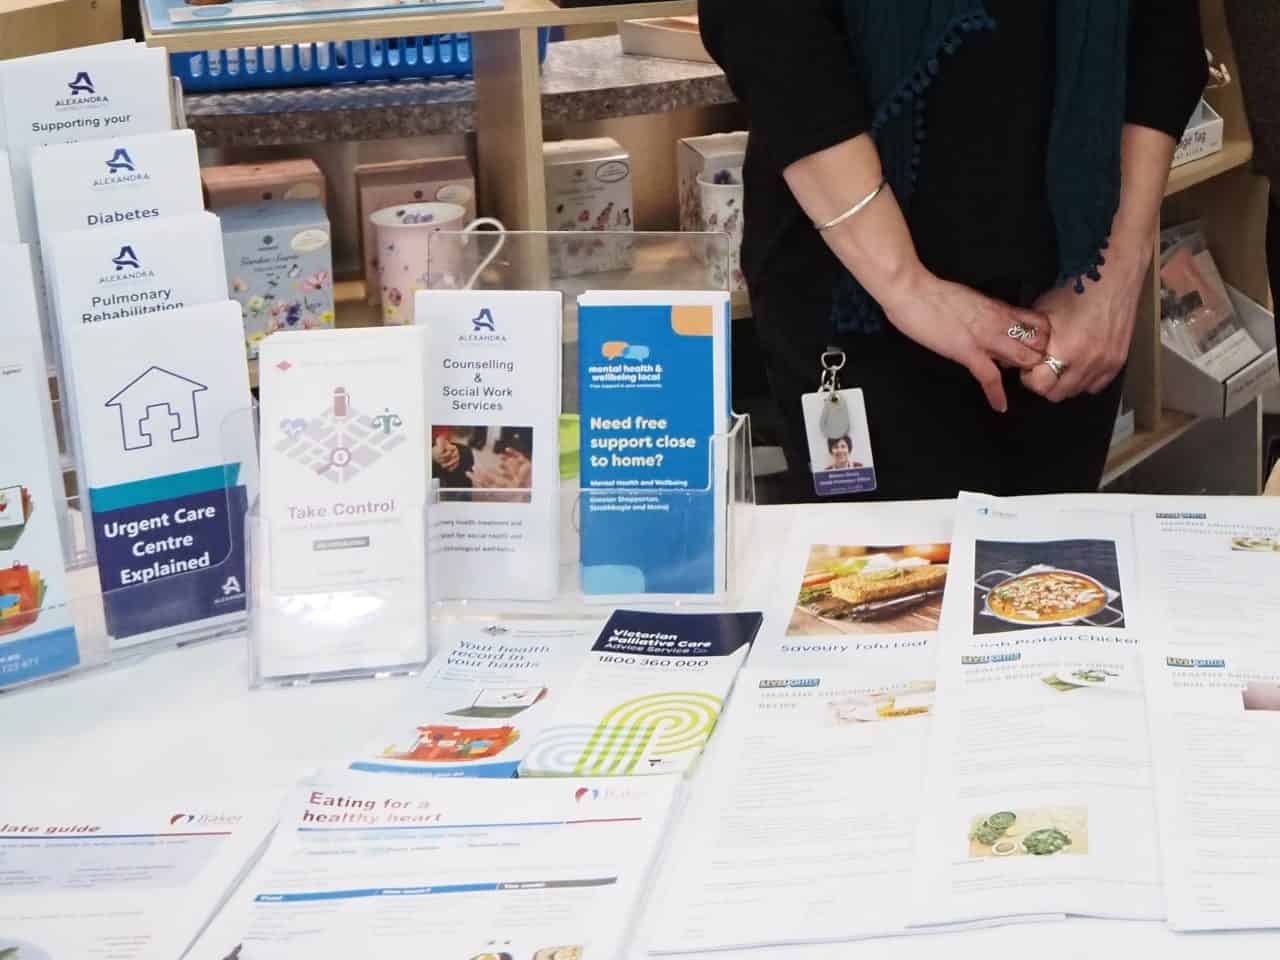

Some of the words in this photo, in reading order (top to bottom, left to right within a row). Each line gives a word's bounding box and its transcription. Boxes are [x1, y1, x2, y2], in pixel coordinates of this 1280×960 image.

[55, 94, 109, 107] ALEXANDRA
[31, 116, 101, 133] Supporting
[103, 113, 132, 131] your
[92, 172, 150, 187] ALEXANDRA
[87, 207, 160, 227] Diabetes
[98, 269, 155, 284] ALEXANDRA
[91, 288, 172, 308] Pulmonary
[81, 302, 184, 325] Rehabilitation
[458, 334, 507, 343] ALEXANDRA
[442, 358, 515, 371] Counselling
[589, 365, 622, 373] mental
[624, 364, 653, 373] health
[473, 373, 483, 384] &
[592, 373, 636, 383] wellbeing
[638, 373, 661, 381] local
[442, 386, 480, 398] Social
[483, 386, 514, 398] Work
[451, 400, 504, 411] Services
[590, 416, 631, 430] Need
[635, 416, 668, 430] free
[590, 437, 653, 452] support
[655, 435, 697, 449] close
[590, 455, 608, 467] to
[611, 453, 664, 467] home?
[288, 505, 328, 521] Take
[332, 499, 396, 518] Control
[103, 510, 170, 539] Urgent
[174, 504, 217, 526] Care
[131, 532, 194, 558] Centre
[119, 551, 211, 586] Explained
[608, 635, 677, 648] Palliative
[678, 639, 713, 648] Care
[613, 629, 678, 641] Victorian
[459, 640, 490, 651] Your
[498, 643, 550, 654] health
[604, 642, 644, 652] Advice
[648, 645, 690, 654] Service
[780, 642, 849, 655] Savoury
[855, 639, 894, 653] Tofu
[896, 637, 930, 650] Loaf
[450, 649, 501, 660] record
[508, 651, 525, 661] in
[447, 658, 487, 670] your
[487, 660, 540, 669] hands
[639, 657, 671, 667] 360
[676, 659, 710, 668] 000
[309, 790, 377, 810] Eating
[383, 797, 410, 810] for
[418, 802, 431, 810] a
[302, 809, 380, 826] healthy
[387, 812, 442, 824] heart
[45, 823, 102, 835] guide
